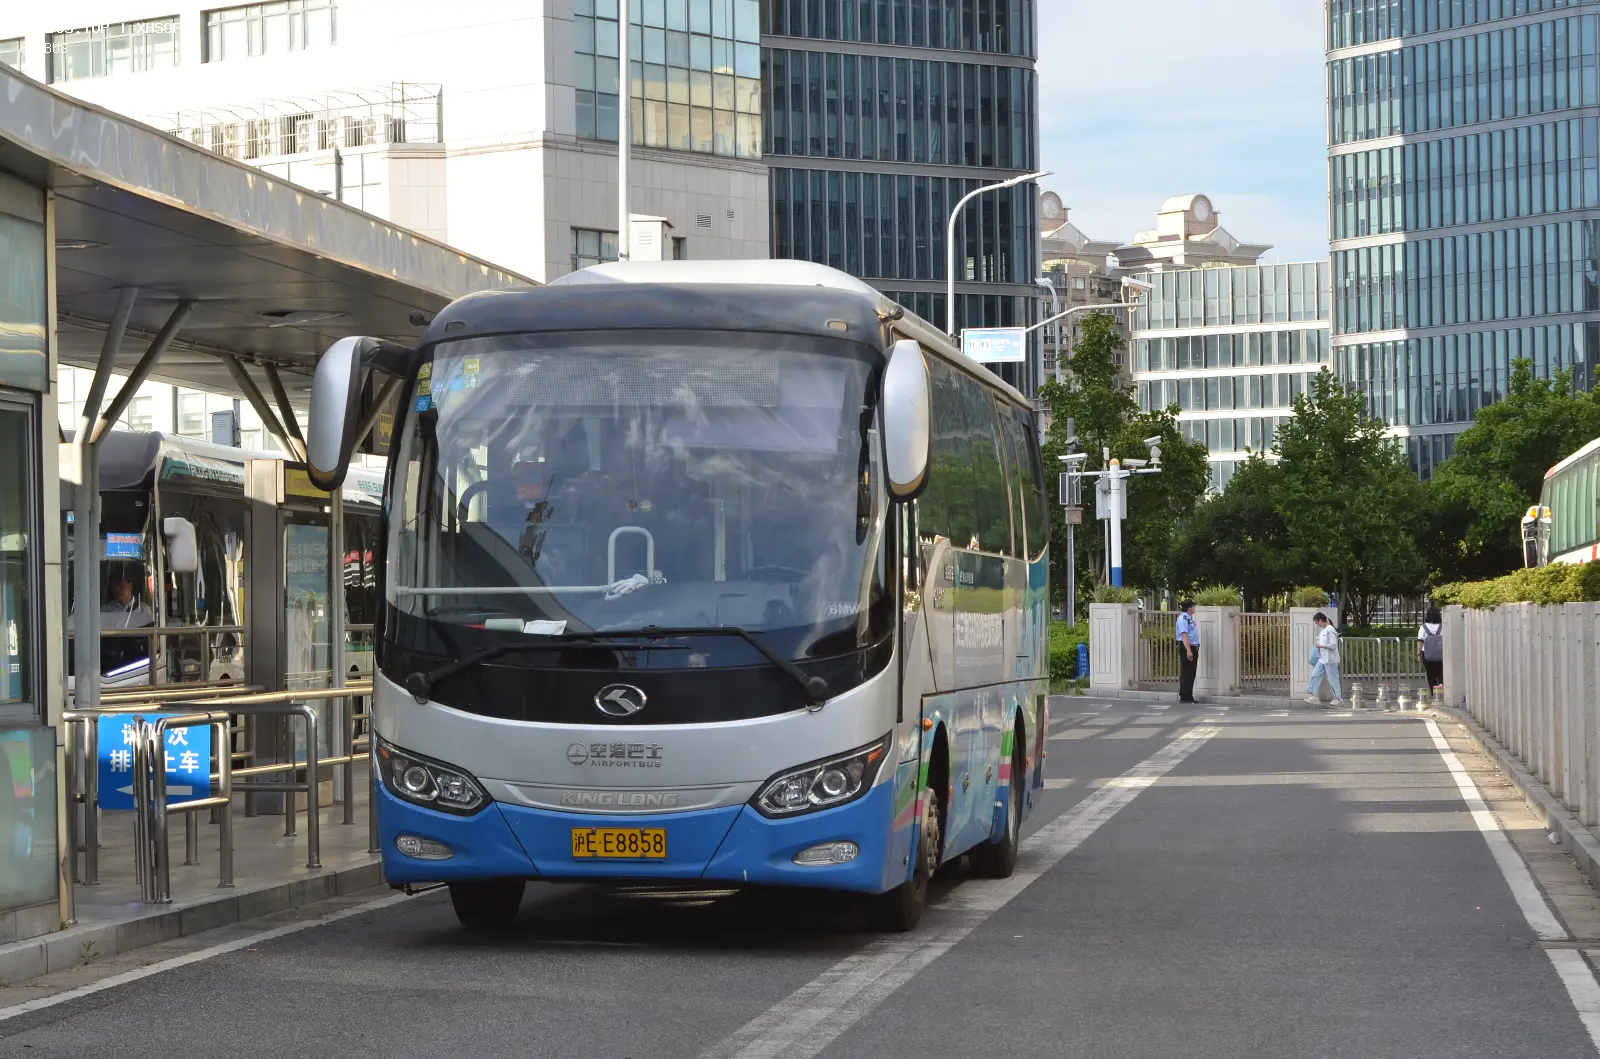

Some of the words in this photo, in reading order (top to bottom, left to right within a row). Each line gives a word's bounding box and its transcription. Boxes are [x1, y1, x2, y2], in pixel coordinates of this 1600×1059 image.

[121, 723, 188, 746] 请次
[590, 741, 664, 759] 空港巴士
[110, 750, 200, 774] 排上车
